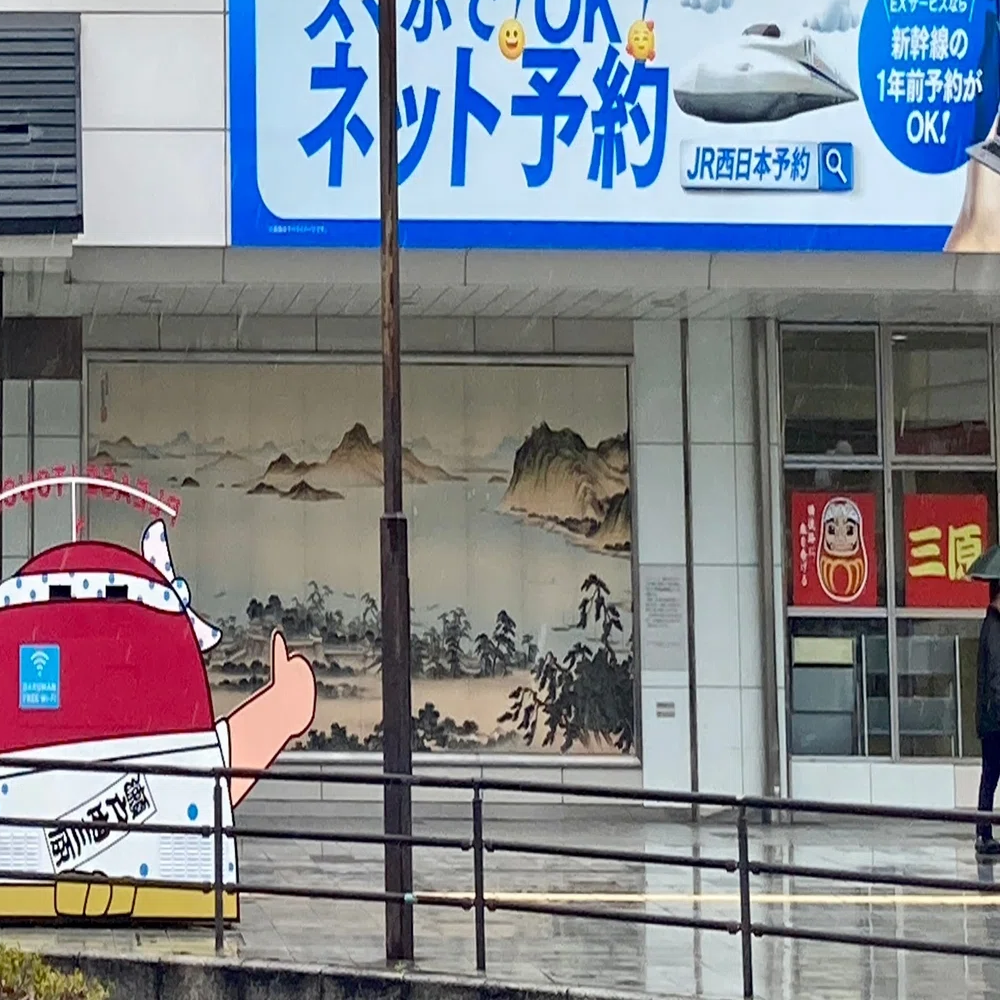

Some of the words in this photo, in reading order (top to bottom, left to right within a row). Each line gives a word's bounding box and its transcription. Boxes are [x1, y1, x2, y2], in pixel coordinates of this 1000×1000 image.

[891, 24, 969, 63] 新幹線の
[877, 68, 984, 104] 1年前予約が
[298, 42, 670, 189] ネット予約
[906, 110, 951, 145] OK!
[687, 146, 811, 182] JR西日本予約
[908, 524, 982, 581] 三原
